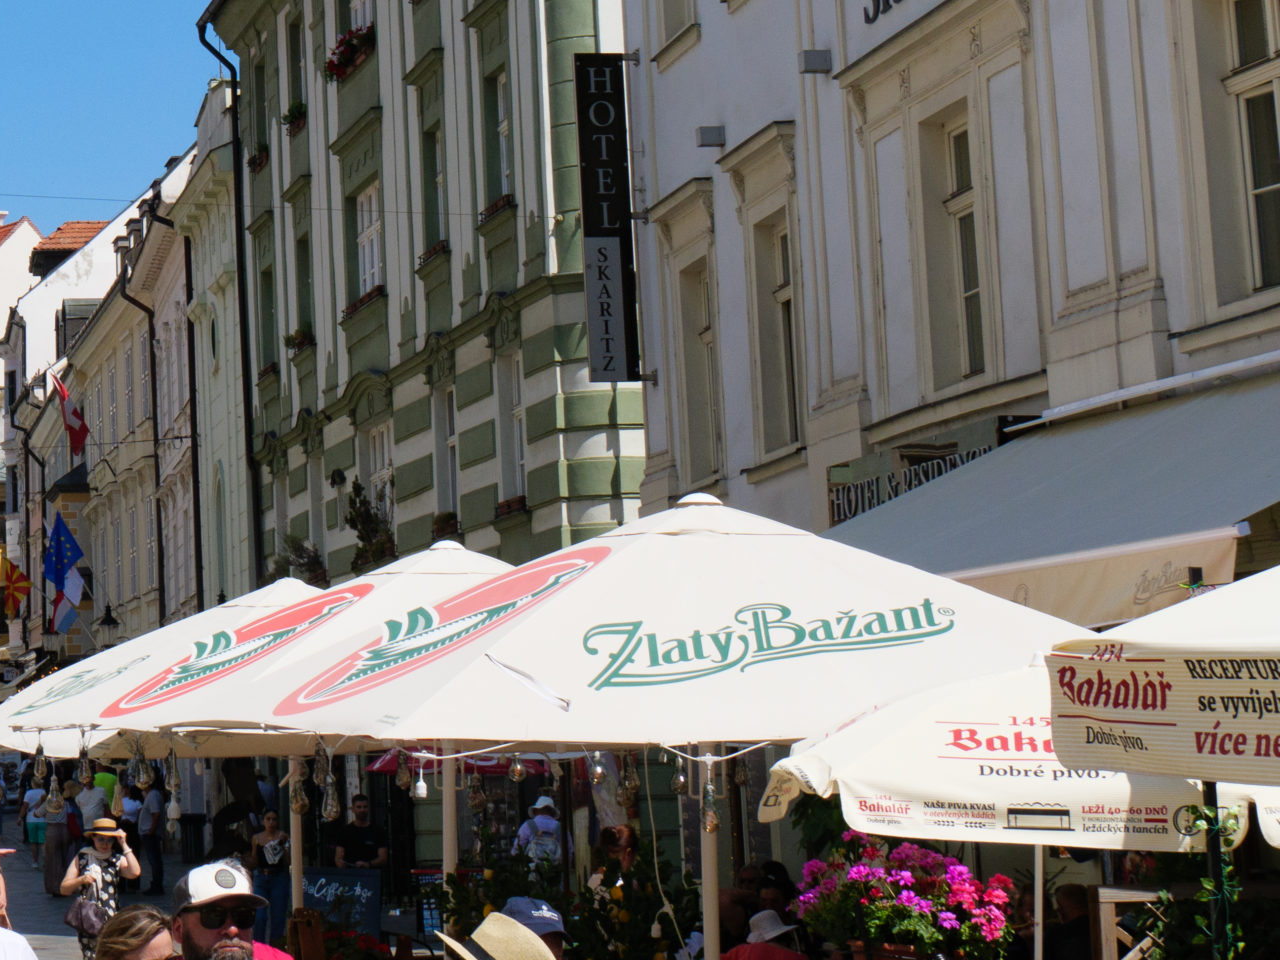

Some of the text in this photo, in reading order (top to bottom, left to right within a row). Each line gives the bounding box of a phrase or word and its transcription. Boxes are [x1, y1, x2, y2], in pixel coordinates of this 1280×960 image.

[586, 67, 620, 228] HOTEL
[597, 246, 616, 372] SKARITZ
[832, 476, 886, 521] HOTEL
[582, 597, 947, 691] Zlatý Bažant
[1184, 659, 1280, 680] RECEPTUR
[1057, 665, 1173, 711] Bakalář
[1198, 688, 1280, 720] se vyvíjel
[1008, 715, 1052, 727] 145
[1085, 725, 1149, 753] Dobré pivo.
[1195, 720, 1280, 758] více ne
[978, 764, 1045, 778] Dobré
[858, 799, 911, 816] Bakalář
[923, 800, 996, 811] NAŠE PIVA KVASÍ
[929, 809, 970, 820] otevřených
[1081, 804, 1105, 814] LEŽÍ
[1144, 804, 1168, 816] DNŮ
[1082, 823, 1168, 835] ležáckých tancích
